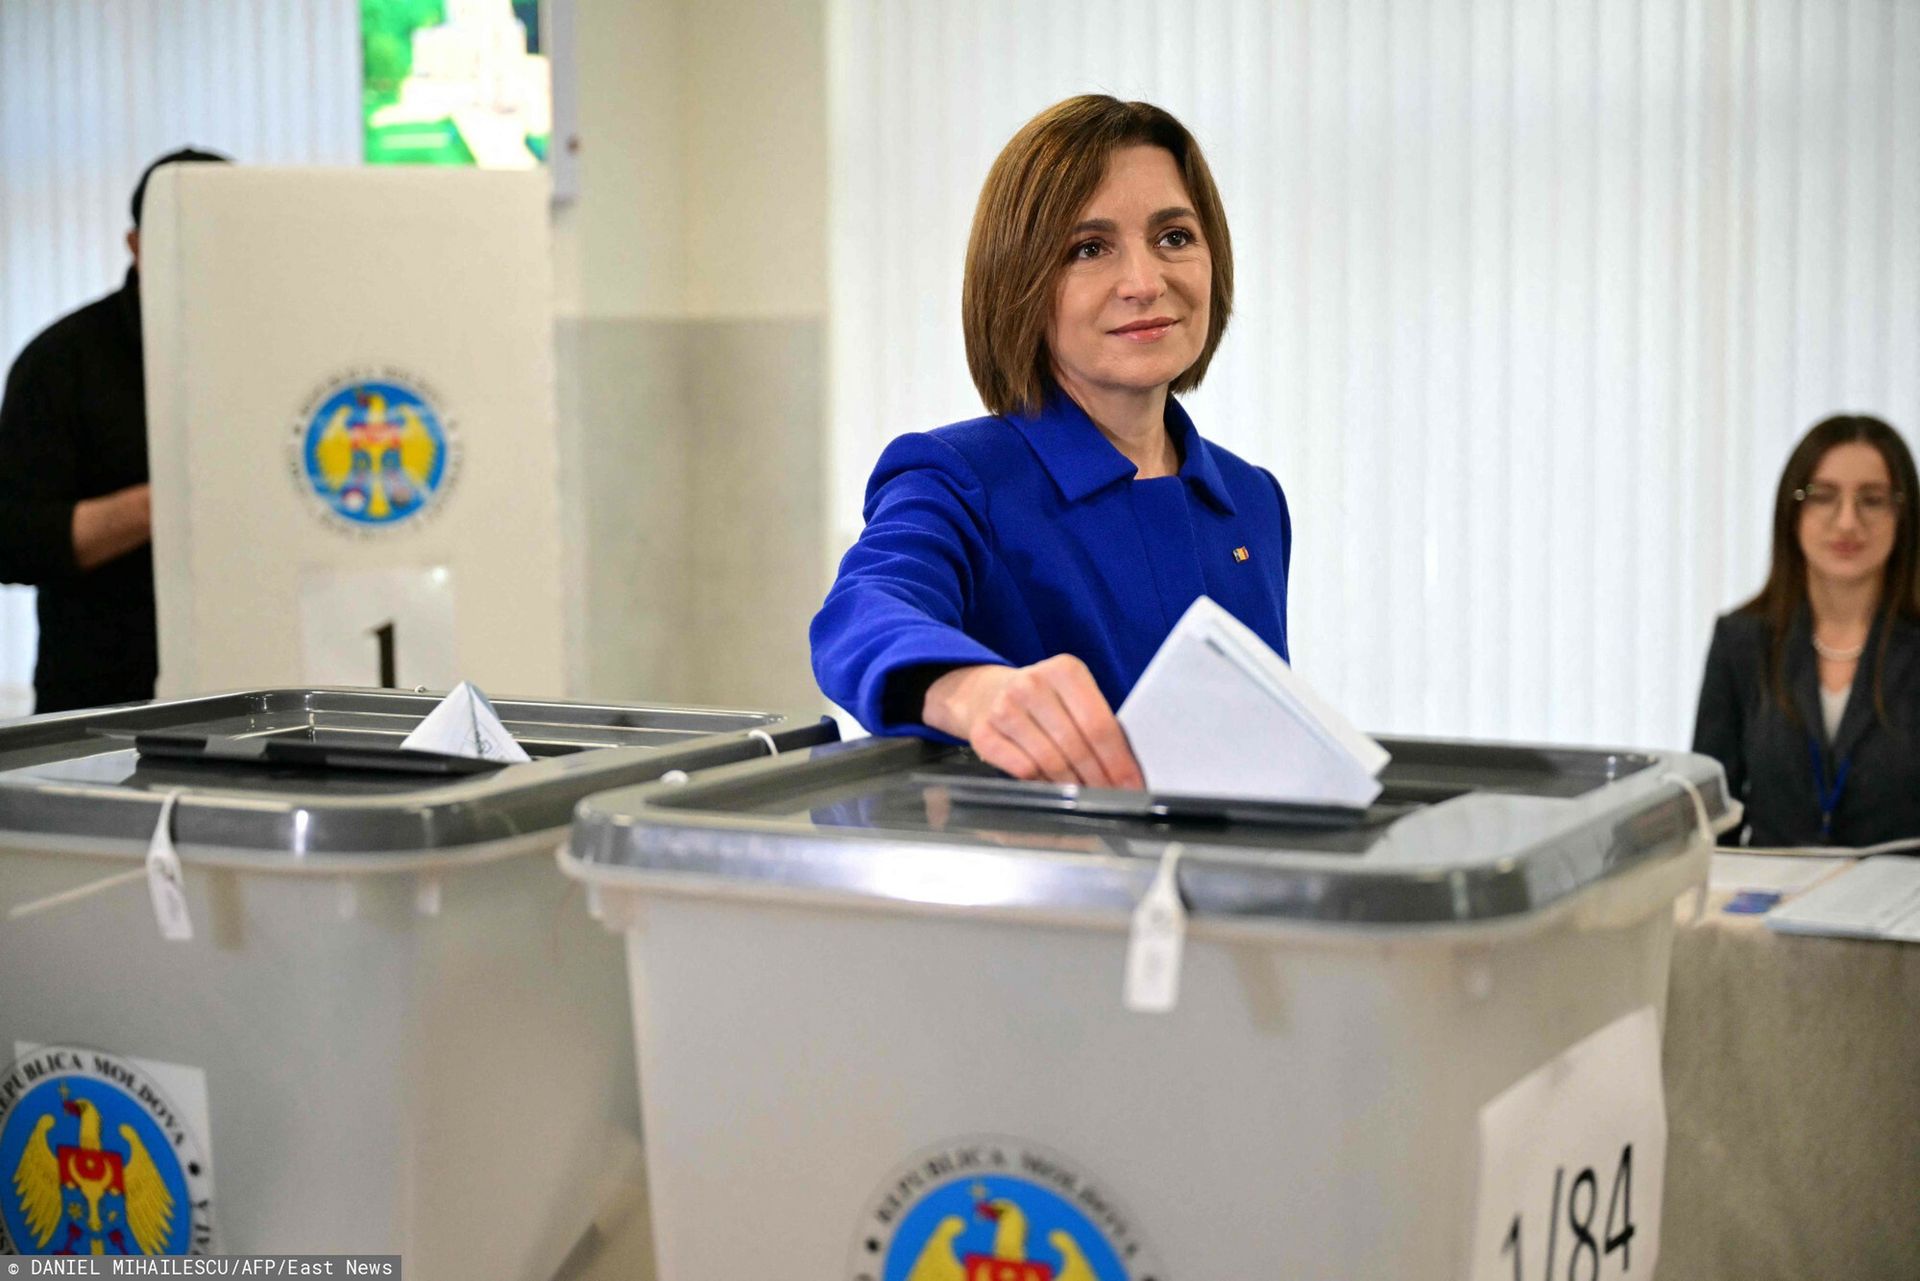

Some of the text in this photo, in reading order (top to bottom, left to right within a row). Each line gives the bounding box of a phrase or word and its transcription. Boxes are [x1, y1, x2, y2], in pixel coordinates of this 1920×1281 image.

[365, 618, 396, 688] 1
[0, 1051, 184, 1147] EPUBLICA MOLDOVA
